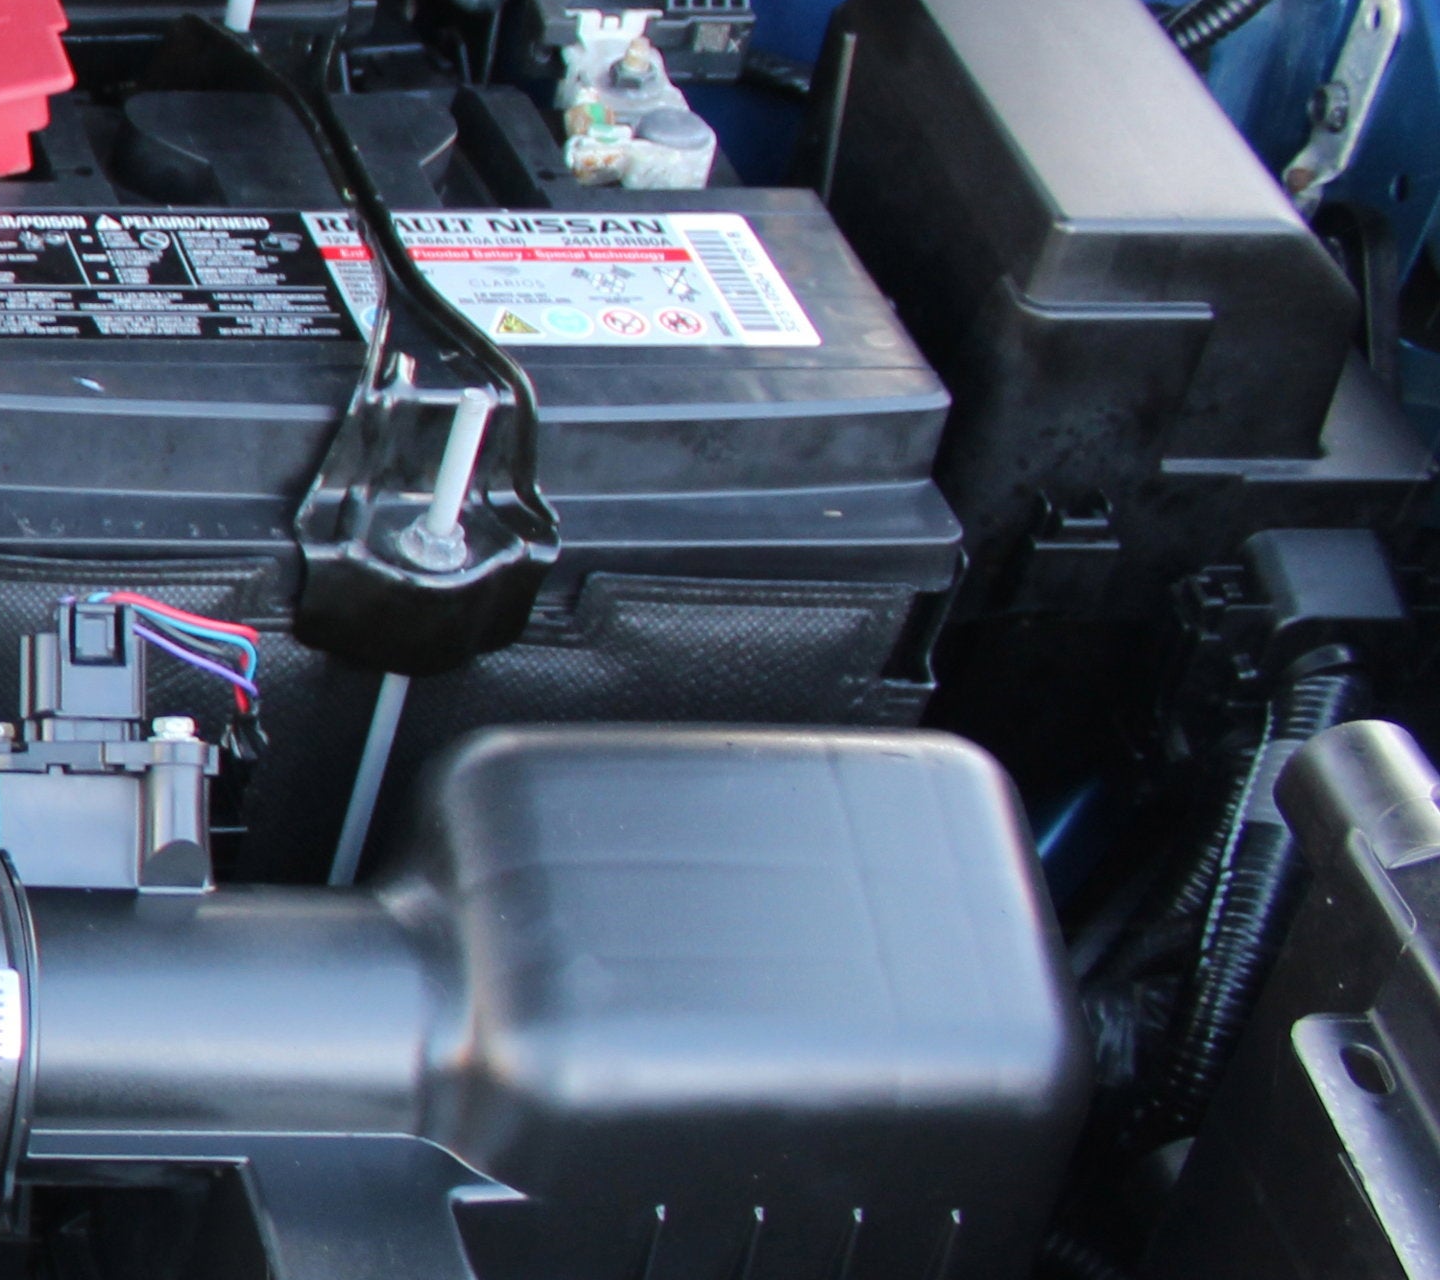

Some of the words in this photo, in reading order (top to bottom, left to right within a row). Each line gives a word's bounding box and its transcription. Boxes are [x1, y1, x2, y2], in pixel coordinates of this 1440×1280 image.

[487, 218, 667, 235] NISSAN
[411, 249, 470, 260] Flooded
[472, 250, 523, 262] Battery
[534, 251, 586, 262] Special
[589, 250, 666, 262] technology
[468, 278, 546, 288] CLARIOS
